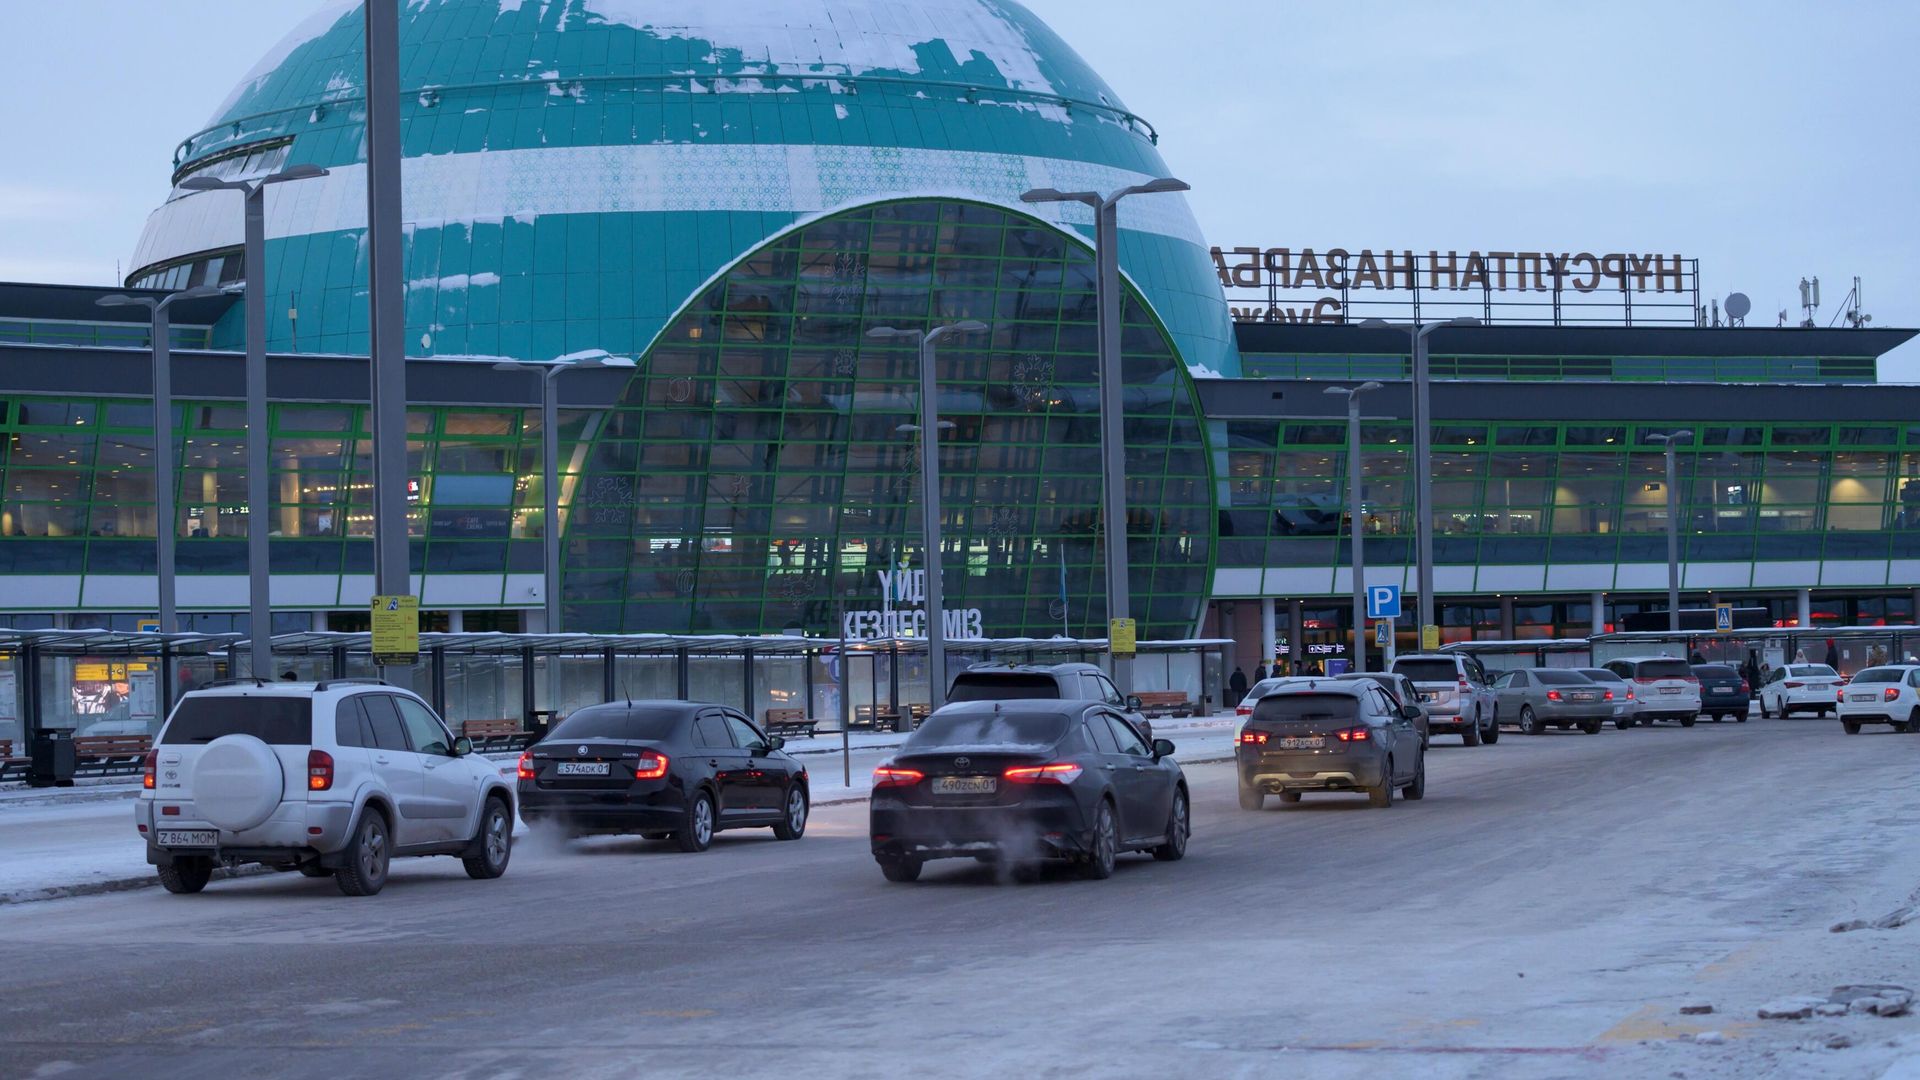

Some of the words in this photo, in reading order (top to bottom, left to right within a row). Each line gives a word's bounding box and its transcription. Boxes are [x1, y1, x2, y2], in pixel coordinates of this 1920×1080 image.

[372, 600, 380, 609] P
[1374, 587, 1393, 615] P
[160, 832, 168, 844] Z
[170, 833, 189, 844] 864
[191, 832, 215, 843] MOM
